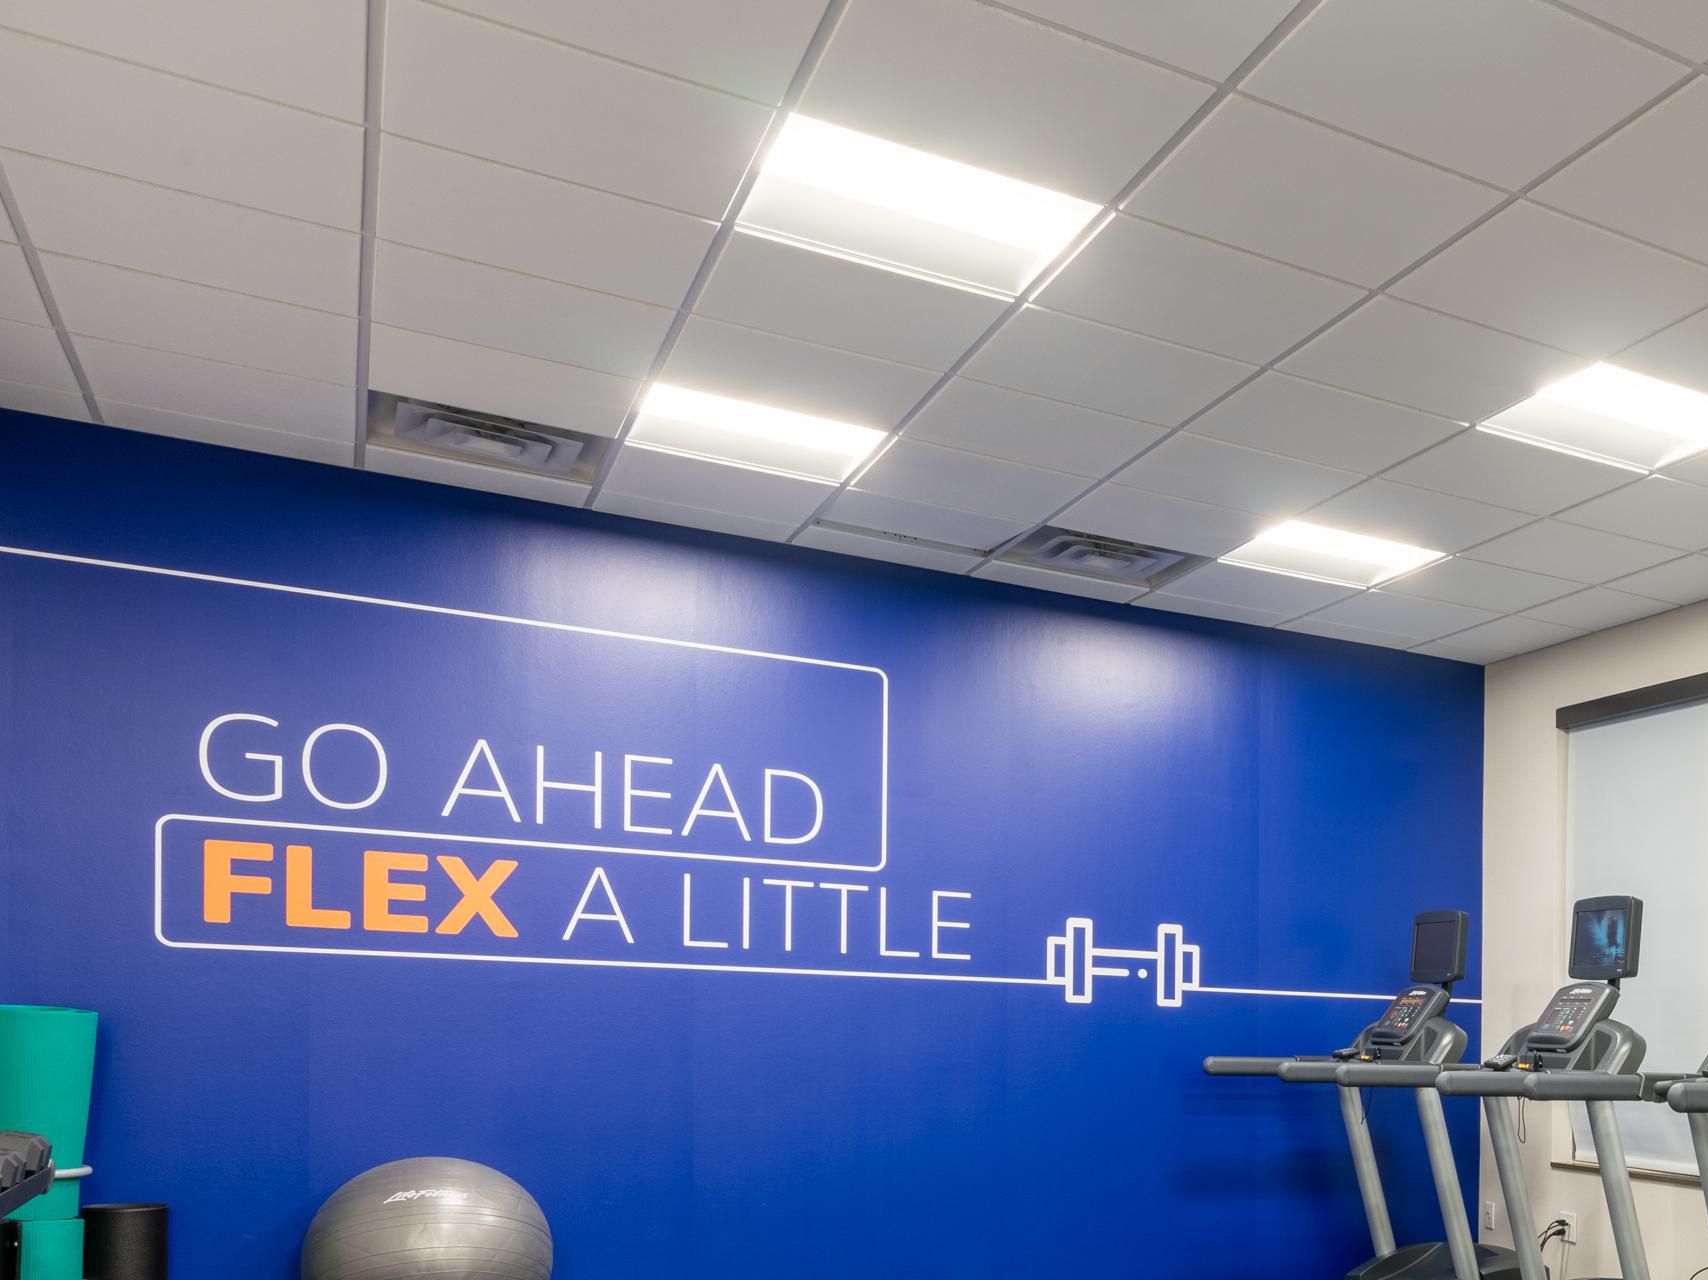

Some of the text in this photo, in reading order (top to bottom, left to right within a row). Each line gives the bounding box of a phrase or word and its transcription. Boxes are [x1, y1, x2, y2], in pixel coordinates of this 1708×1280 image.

[198, 712, 824, 845] GO AHEAD
[203, 837, 973, 961] FLEX A LITTLE
